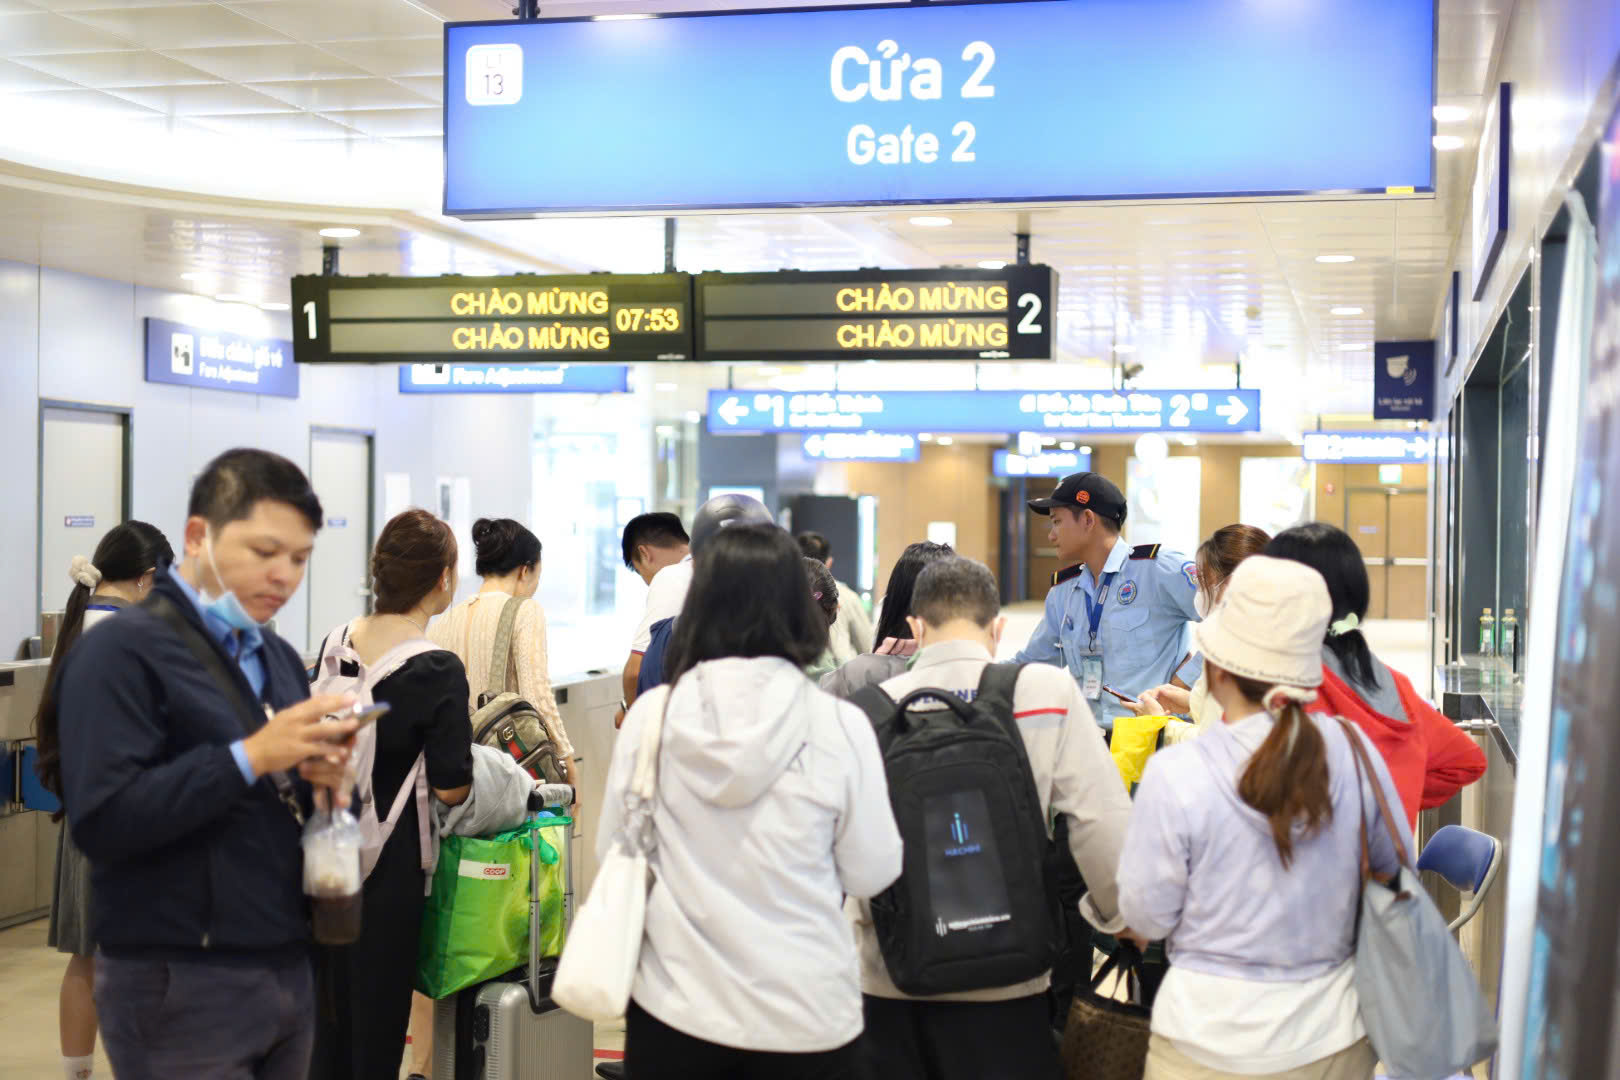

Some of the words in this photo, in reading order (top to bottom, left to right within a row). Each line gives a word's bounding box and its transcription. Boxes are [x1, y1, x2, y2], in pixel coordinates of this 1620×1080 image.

[483, 73, 504, 96] 13
[831, 40, 942, 103] Cửa
[961, 41, 996, 98] 2
[847, 124, 939, 165] Gate
[951, 121, 976, 162] 2
[450, 288, 523, 315] CHÀO
[527, 287, 609, 314] MỪNG
[836, 283, 914, 311] CHÀO
[919, 282, 1008, 310] MỪNG
[303, 301, 317, 340] 1
[615, 308, 679, 332] 07:53
[1017, 293, 1042, 334] 2
[452, 323, 524, 350] CHÀO
[528, 322, 610, 350] MỪNG
[836, 319, 915, 347] CHÀO
[919, 318, 1008, 347] MỪNG
[773, 395, 785, 427] 1
[1169, 394, 1190, 428] 2
